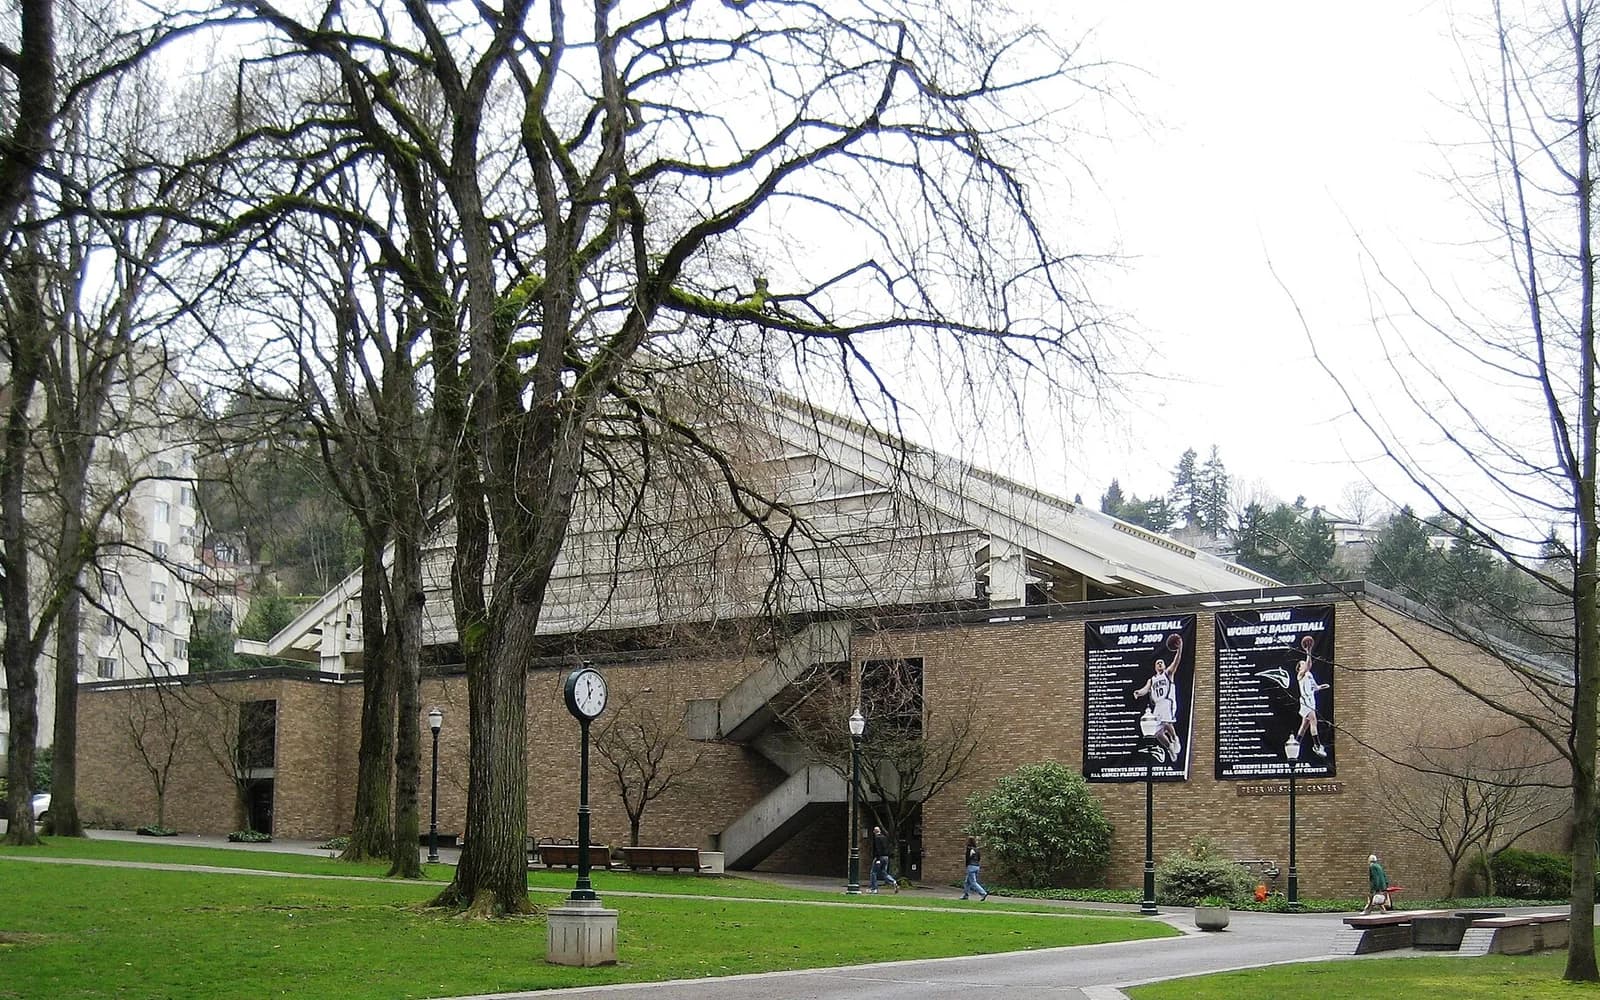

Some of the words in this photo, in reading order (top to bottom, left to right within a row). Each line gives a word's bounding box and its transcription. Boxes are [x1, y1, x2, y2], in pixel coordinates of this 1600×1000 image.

[1260, 612, 1291, 621] VIKING
[1100, 624, 1128, 634] VIKING
[1130, 621, 1182, 632] BASKETBALL
[1227, 625, 1268, 636] WOMEN'S
[1269, 622, 1324, 633] BASKETBALL
[1155, 688, 1164, 697] 10
